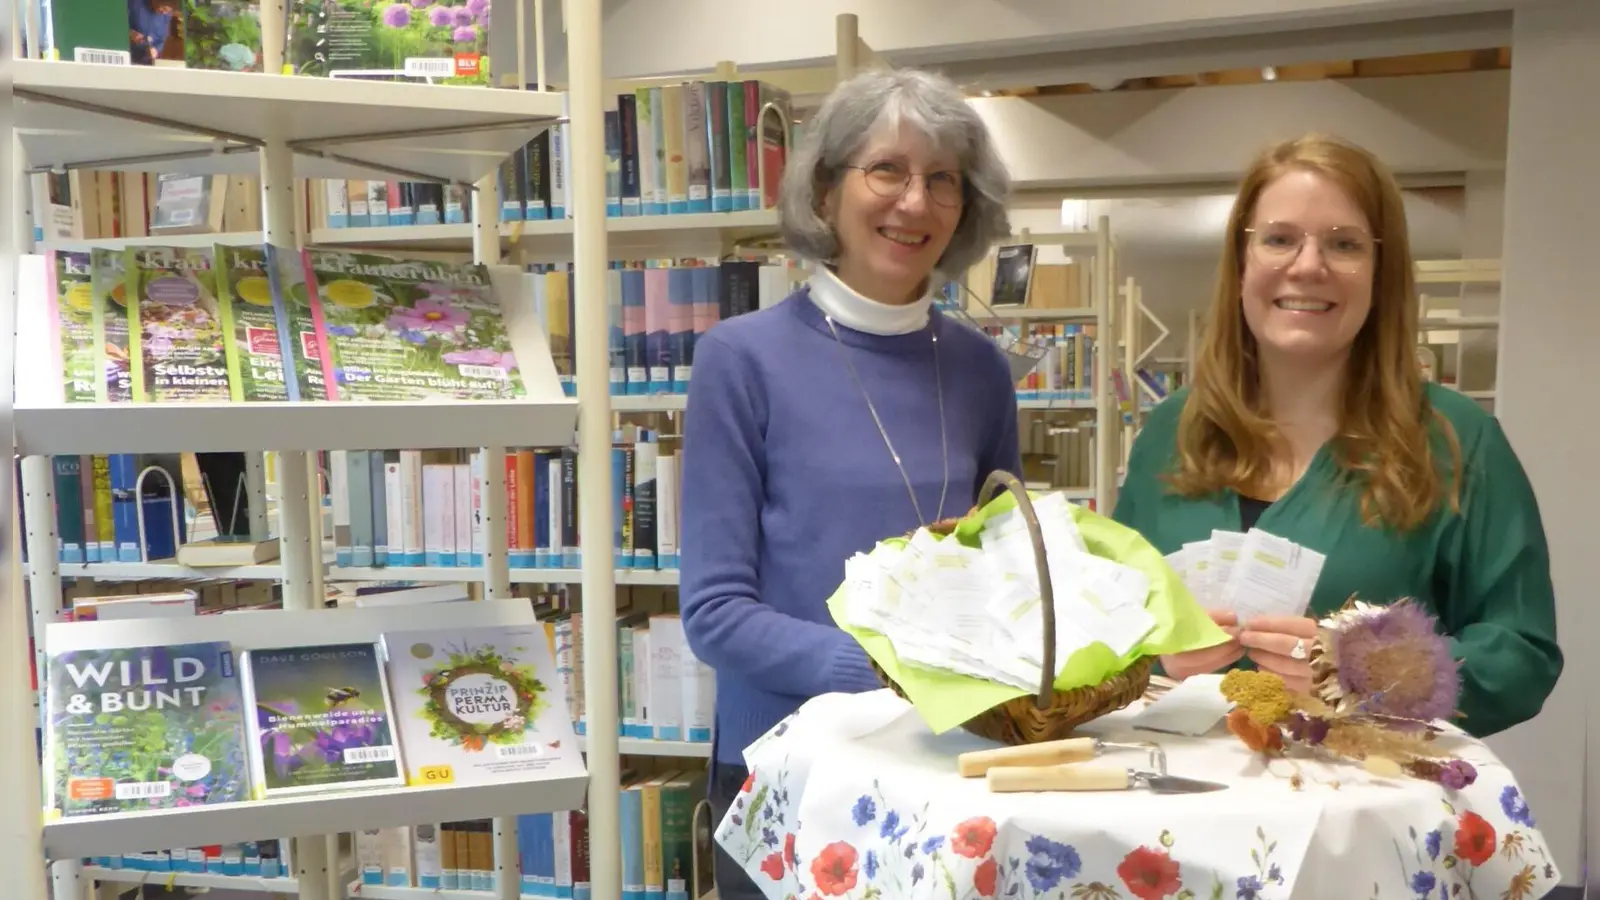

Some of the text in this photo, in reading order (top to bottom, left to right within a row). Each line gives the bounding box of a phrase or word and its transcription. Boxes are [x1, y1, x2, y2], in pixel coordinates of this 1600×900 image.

[155, 376, 228, 386] in kleinen
[345, 372, 371, 382] Der
[375, 374, 425, 386] Garten
[428, 377, 468, 388] blüht
[259, 650, 367, 664] DAVE GOULSON
[65, 657, 205, 689] WILD
[450, 684, 508, 697] PRINZIP
[66, 686, 206, 715] & BUNT
[455, 694, 508, 706] PERMA
[455, 702, 511, 714] KULTUR
[268, 708, 375, 723] Bienenweide und
[278, 715, 384, 730] Hummelparadies
[425, 769, 450, 780] GU
